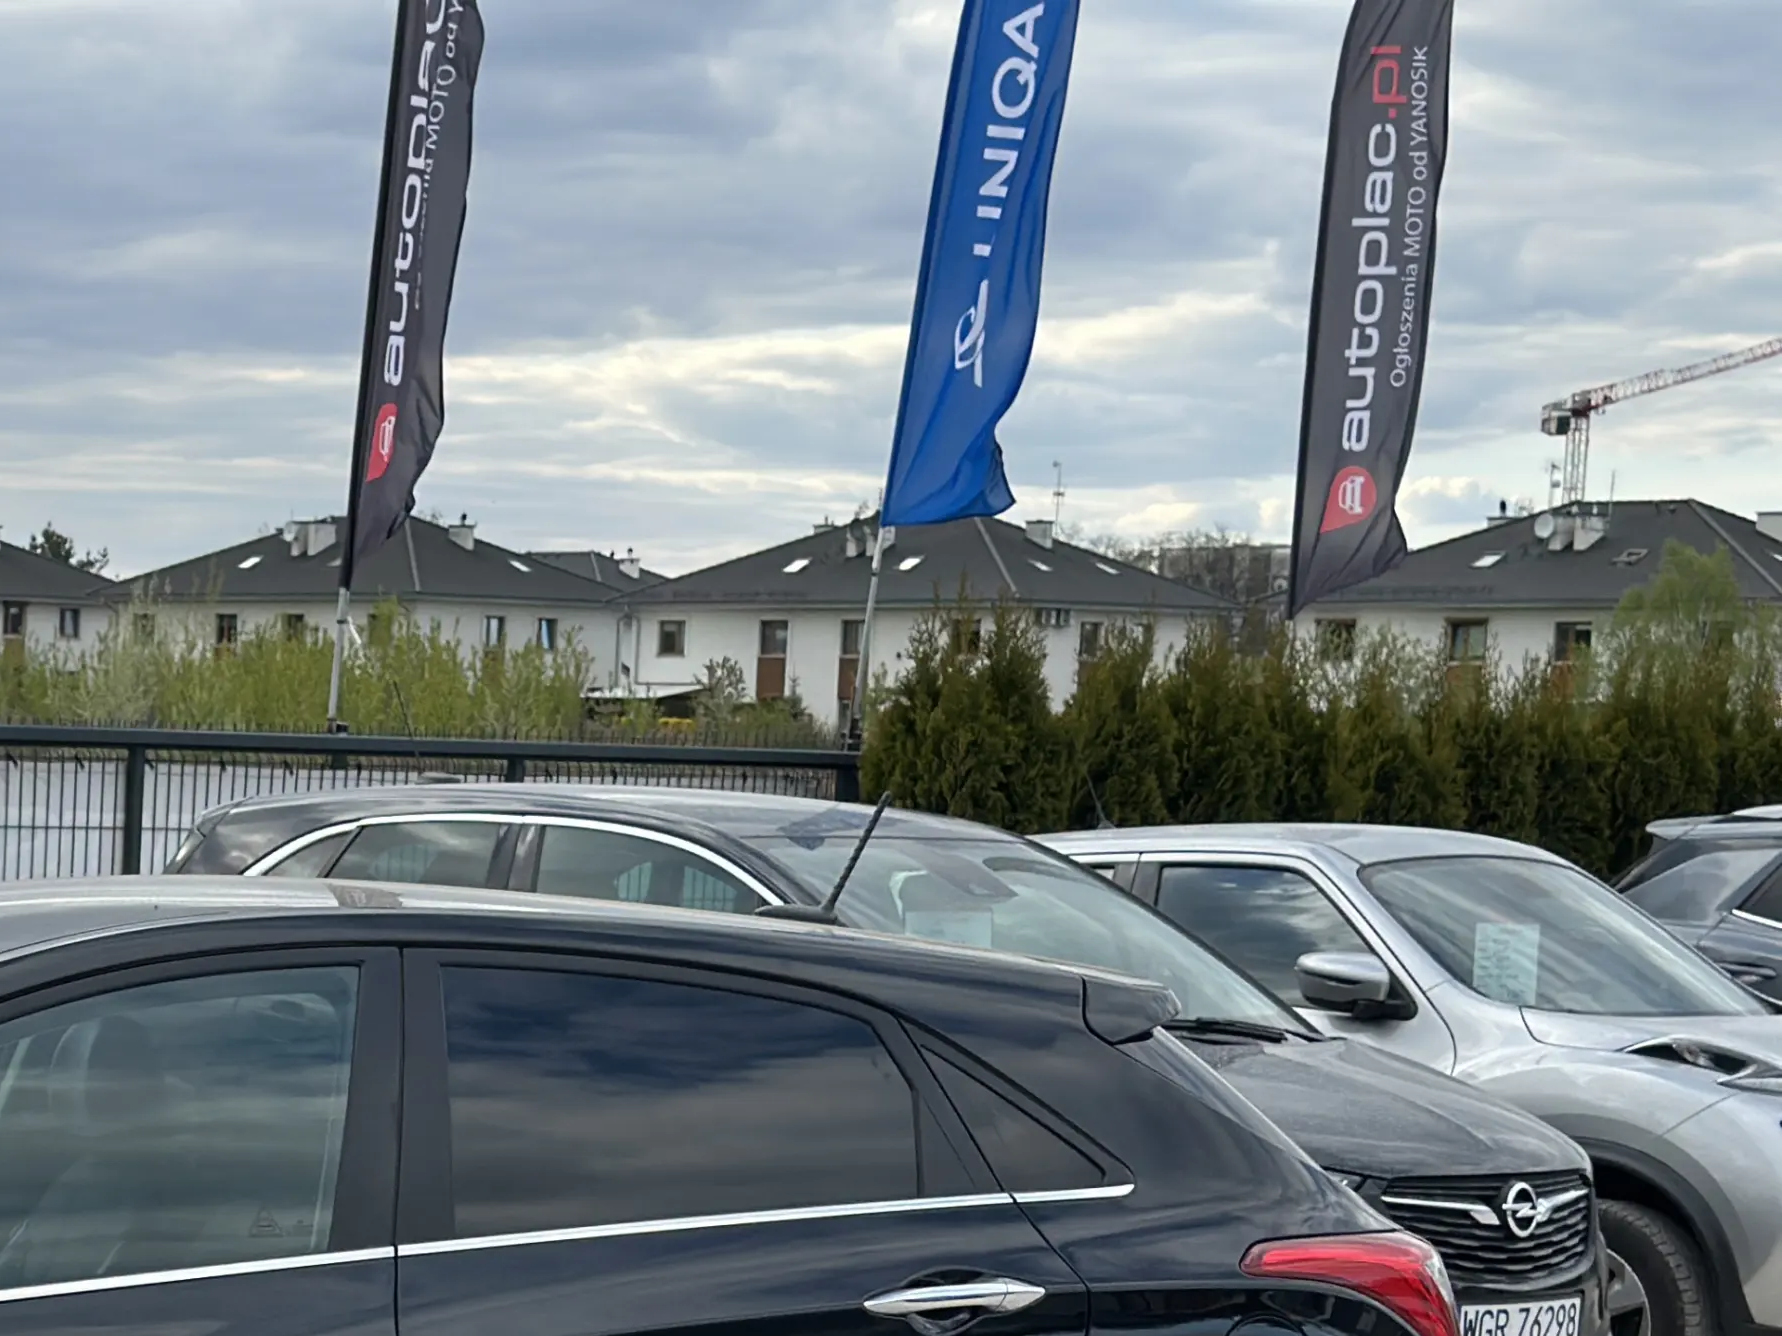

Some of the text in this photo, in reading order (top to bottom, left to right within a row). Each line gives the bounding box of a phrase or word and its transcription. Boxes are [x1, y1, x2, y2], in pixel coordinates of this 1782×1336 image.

[425, 64, 457, 150] MOTO
[1341, 45, 1407, 453] autoplac.pl
[1390, 46, 1428, 388] Ogłoszenia MOTO od YANOSIK
